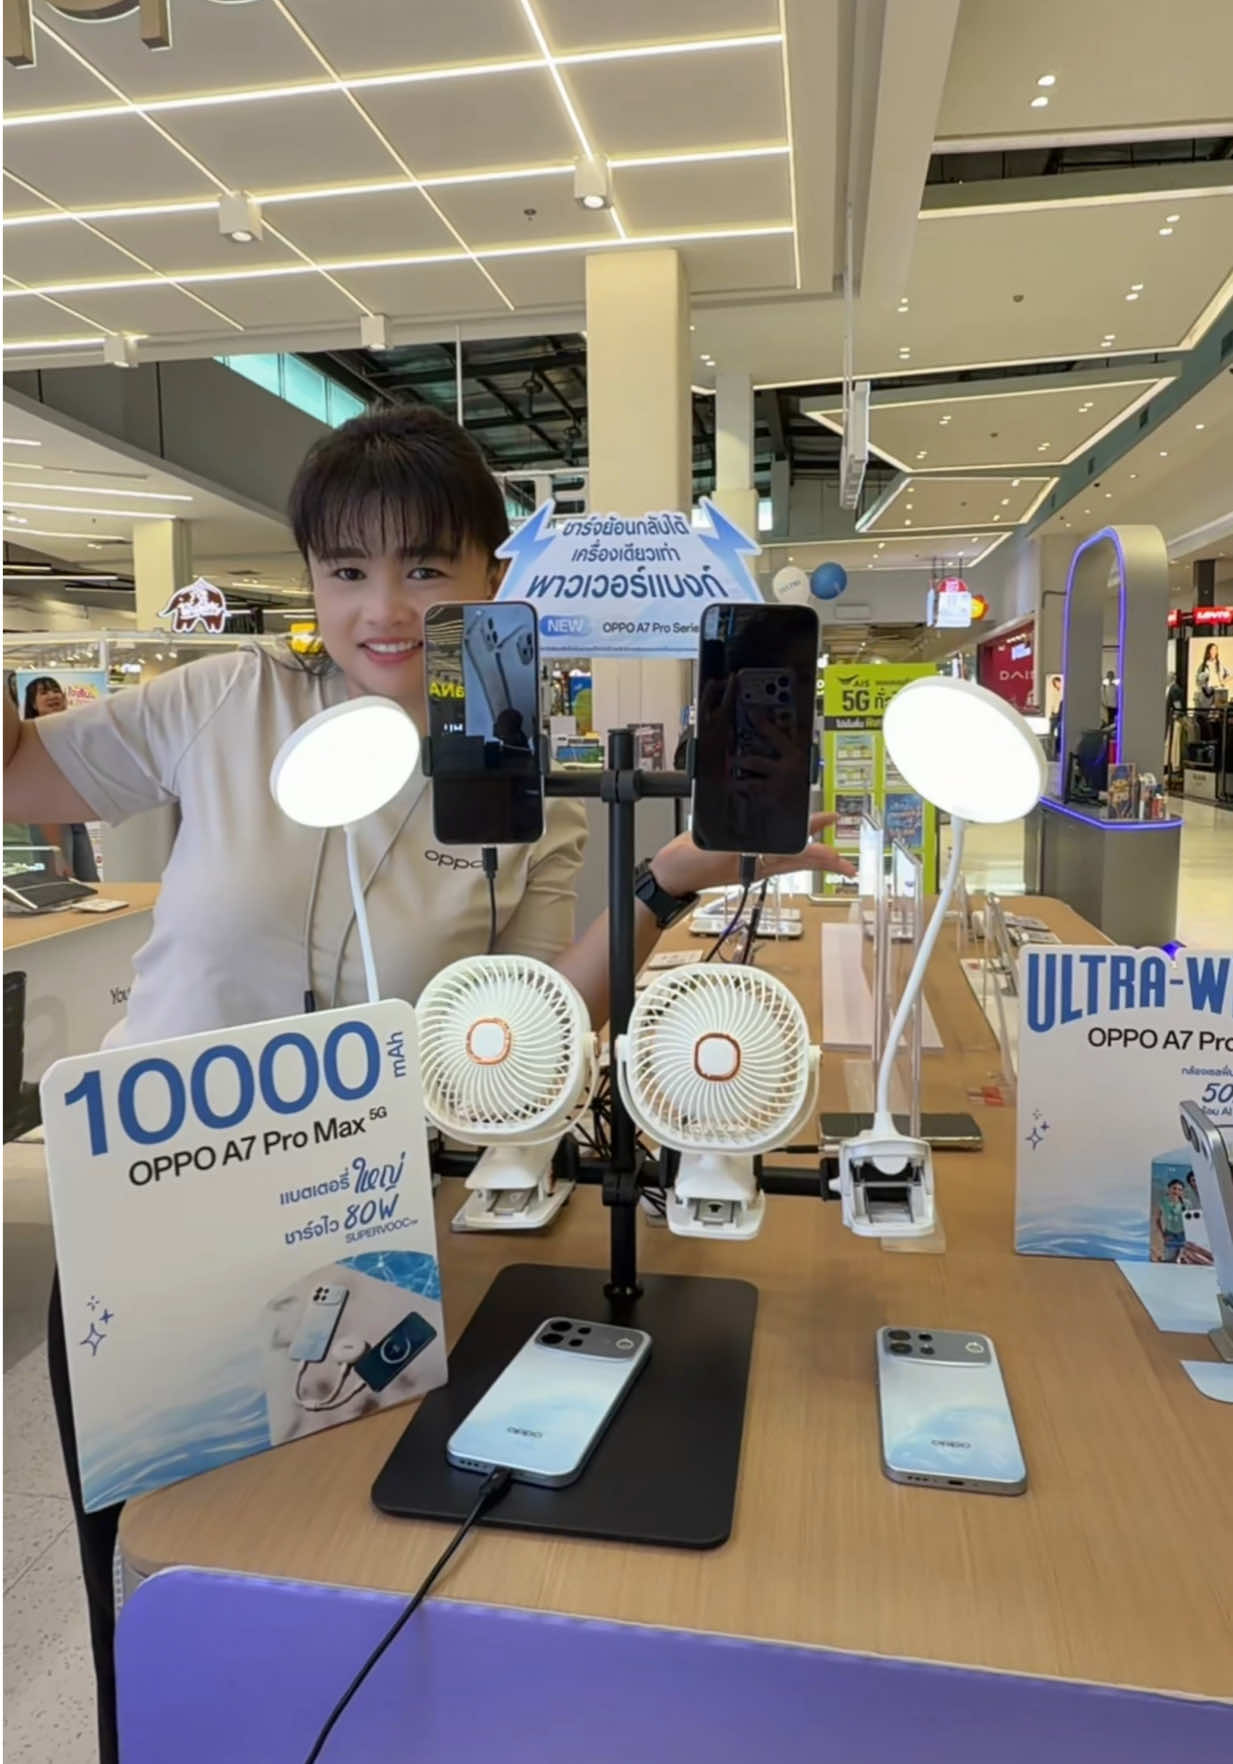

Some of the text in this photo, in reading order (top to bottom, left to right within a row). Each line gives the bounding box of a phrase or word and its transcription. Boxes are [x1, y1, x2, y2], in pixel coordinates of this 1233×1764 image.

[562, 514, 690, 536] ชาร์จย้อนกลับได้
[571, 538, 681, 562] เครื่องเดียวเท่า
[525, 565, 728, 598] พาวเวอร์แบงก์
[547, 619, 584, 633] NEW
[603, 622, 700, 634] OPPO A7 Pro Serie
[1000, 670, 1033, 681] DAI
[842, 690, 870, 712] 5G
[1026, 953, 1233, 1033] ULTRA-W
[1088, 1027, 1158, 1049] OPPO
[1162, 1029, 1194, 1050] A7
[64, 1020, 406, 1156] 10000 mAh
[128, 1106, 388, 1186] OPPO A7 Pro Max 5G
[280, 1151, 406, 1206] แบตเตอรี่ ใหญ่
[284, 1193, 399, 1245] ชาร์จไว 80W
